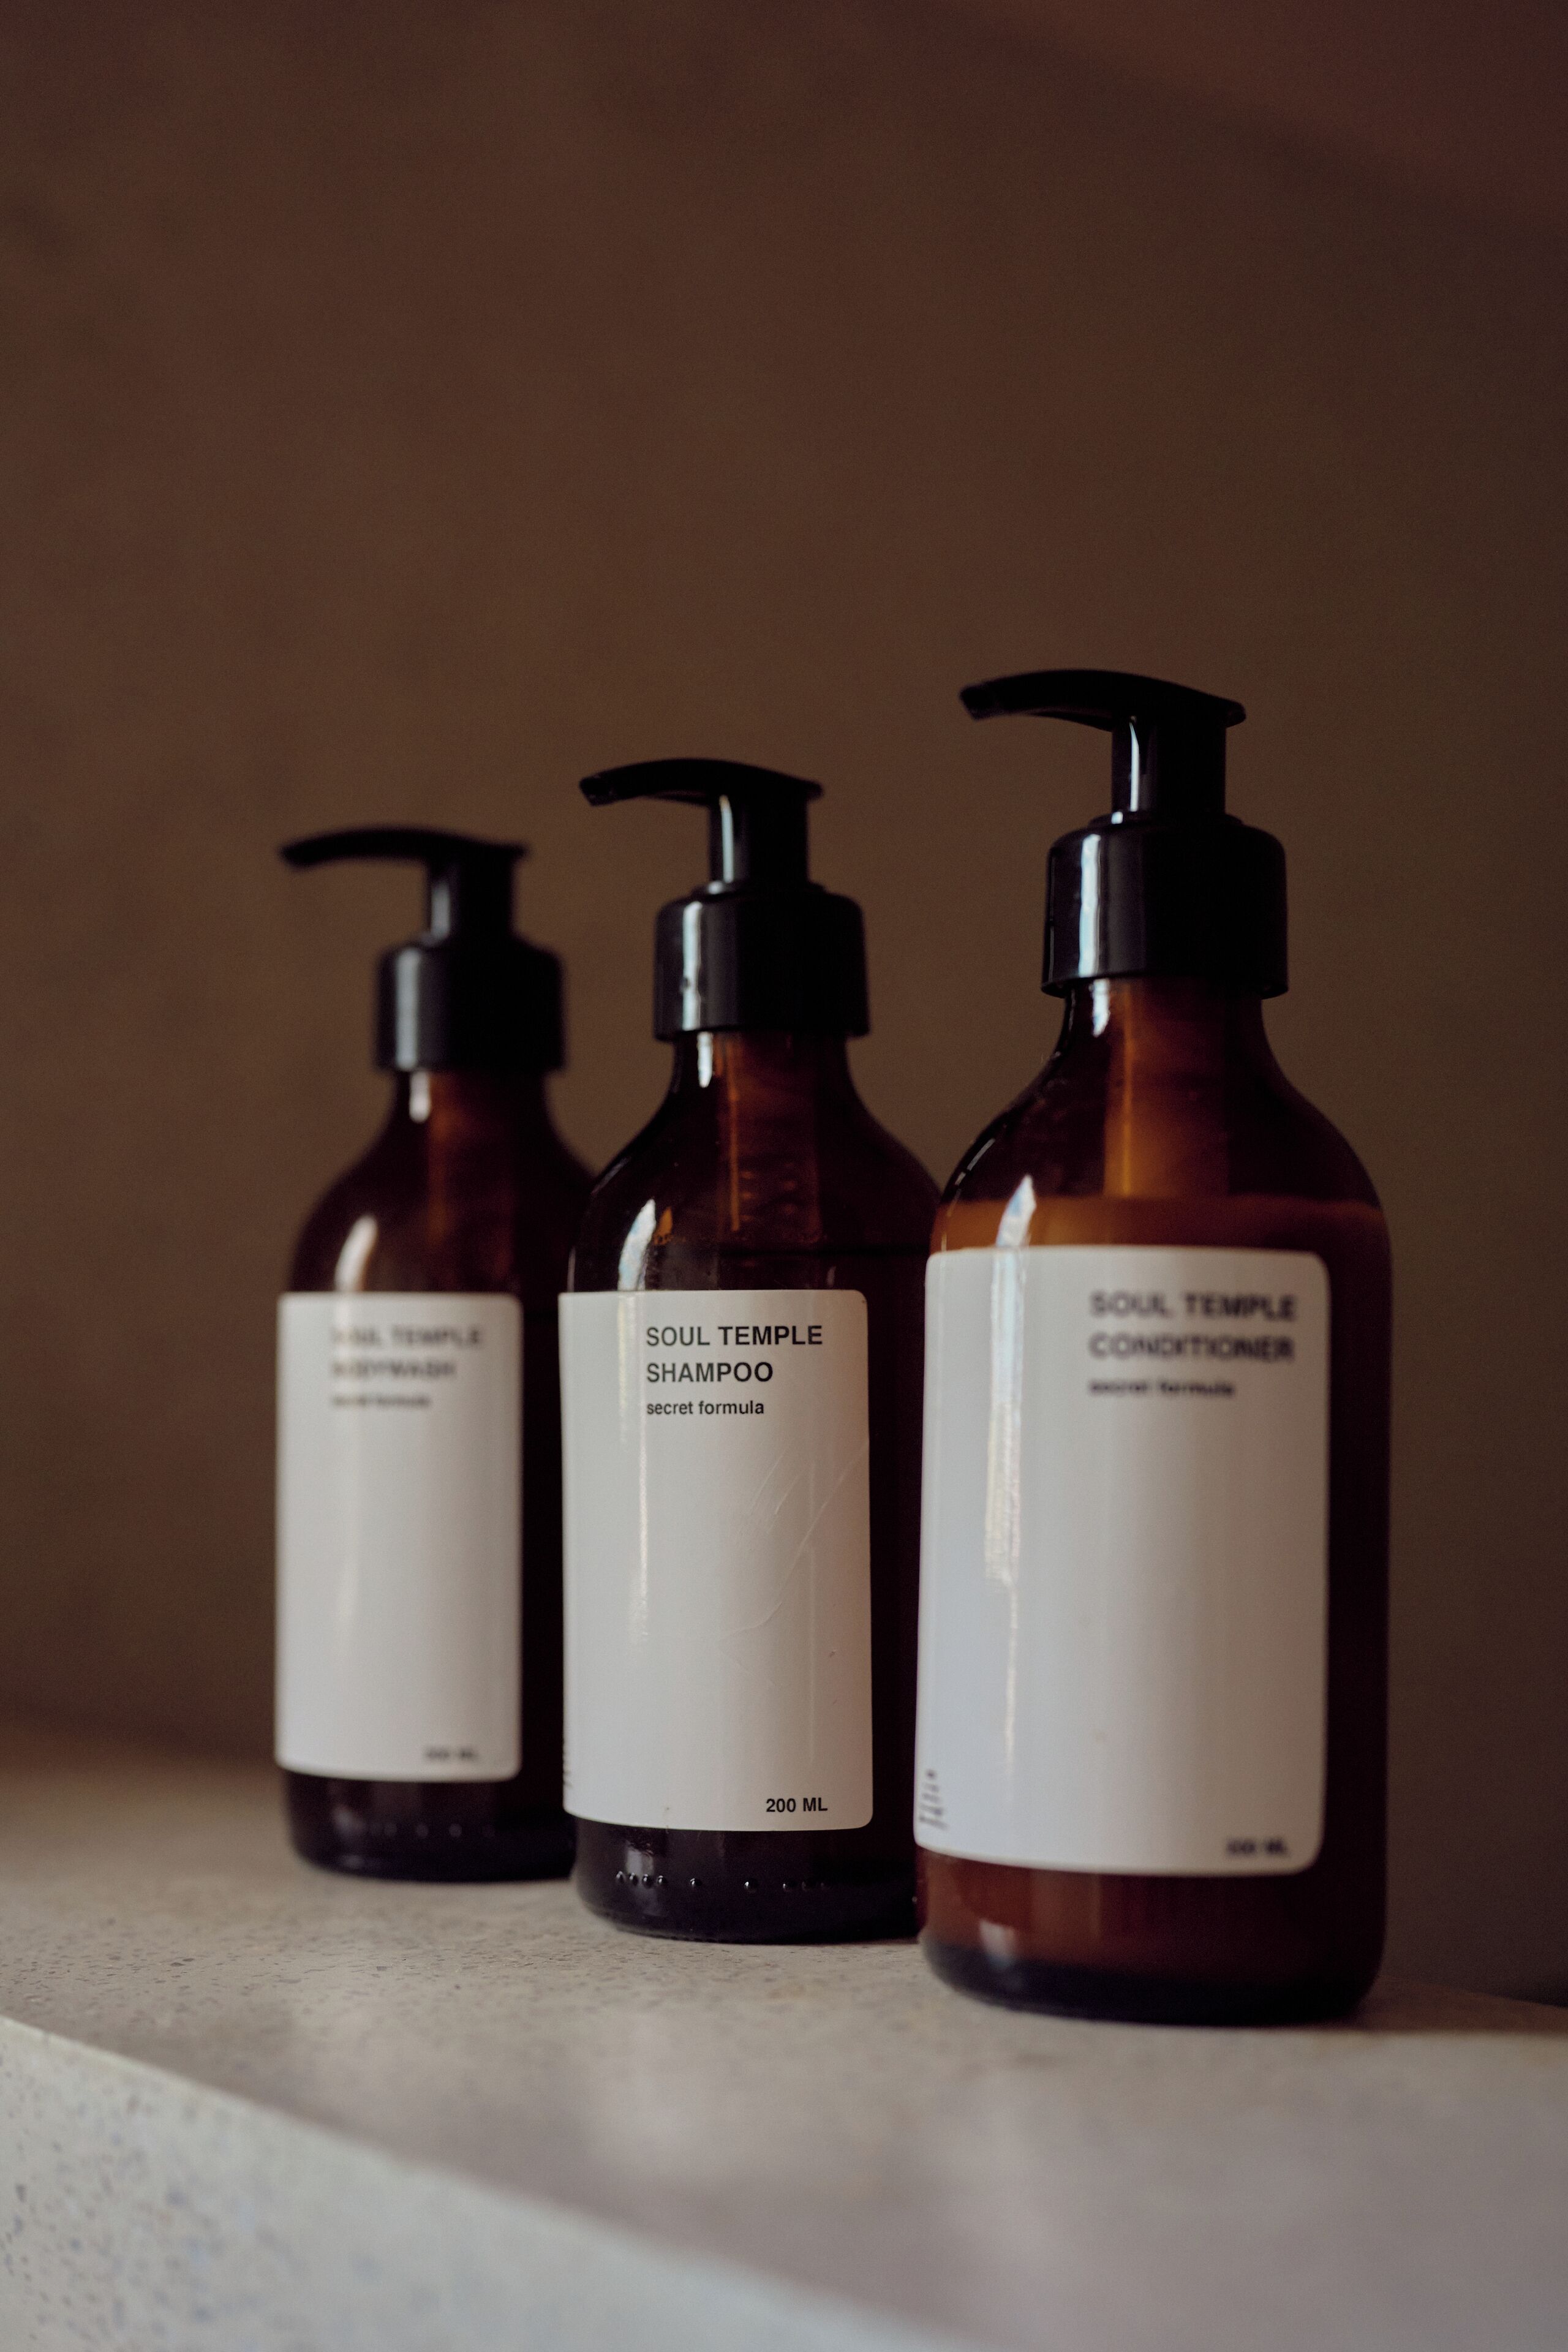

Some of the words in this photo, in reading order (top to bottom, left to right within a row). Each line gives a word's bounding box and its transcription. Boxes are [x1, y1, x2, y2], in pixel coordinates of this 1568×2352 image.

[646, 1326, 710, 1346] SOUL
[718, 1325, 823, 1346] TEMPLE
[647, 1362, 774, 1382] SHAMPOO
[647, 1401, 694, 1415] secret
[698, 1400, 765, 1415] formula
[766, 1798, 797, 1813] 200
[803, 1797, 829, 1812] ML
